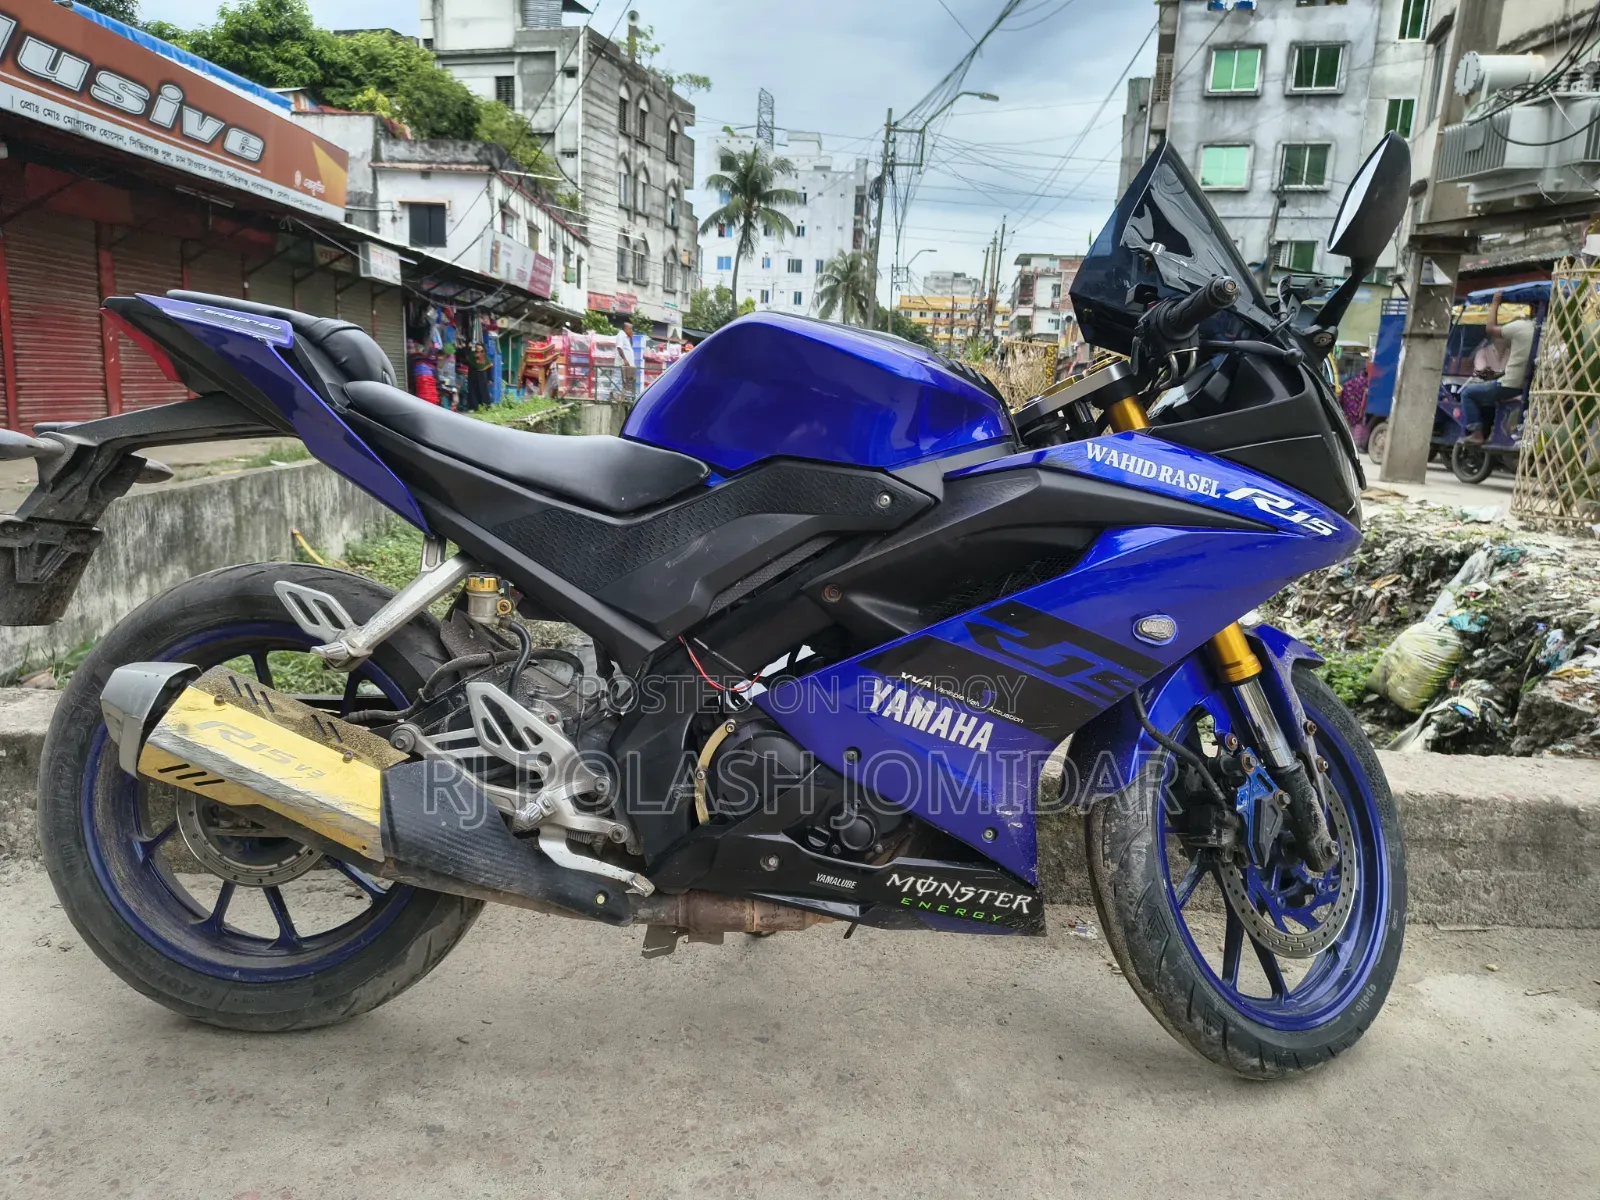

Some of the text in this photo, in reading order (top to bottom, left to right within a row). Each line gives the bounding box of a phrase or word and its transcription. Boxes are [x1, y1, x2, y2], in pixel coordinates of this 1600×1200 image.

[1086, 442, 1157, 479] WAHID
[1158, 466, 1221, 499] RASEL
[868, 679, 995, 752] YAMAHA
[901, 671, 932, 688] VVA
[987, 706, 1024, 724] Actuation
[816, 873, 857, 890] YAMALUBE
[900, 897, 1002, 922] ENERGY
[1355, 983, 1377, 1012] apollo
